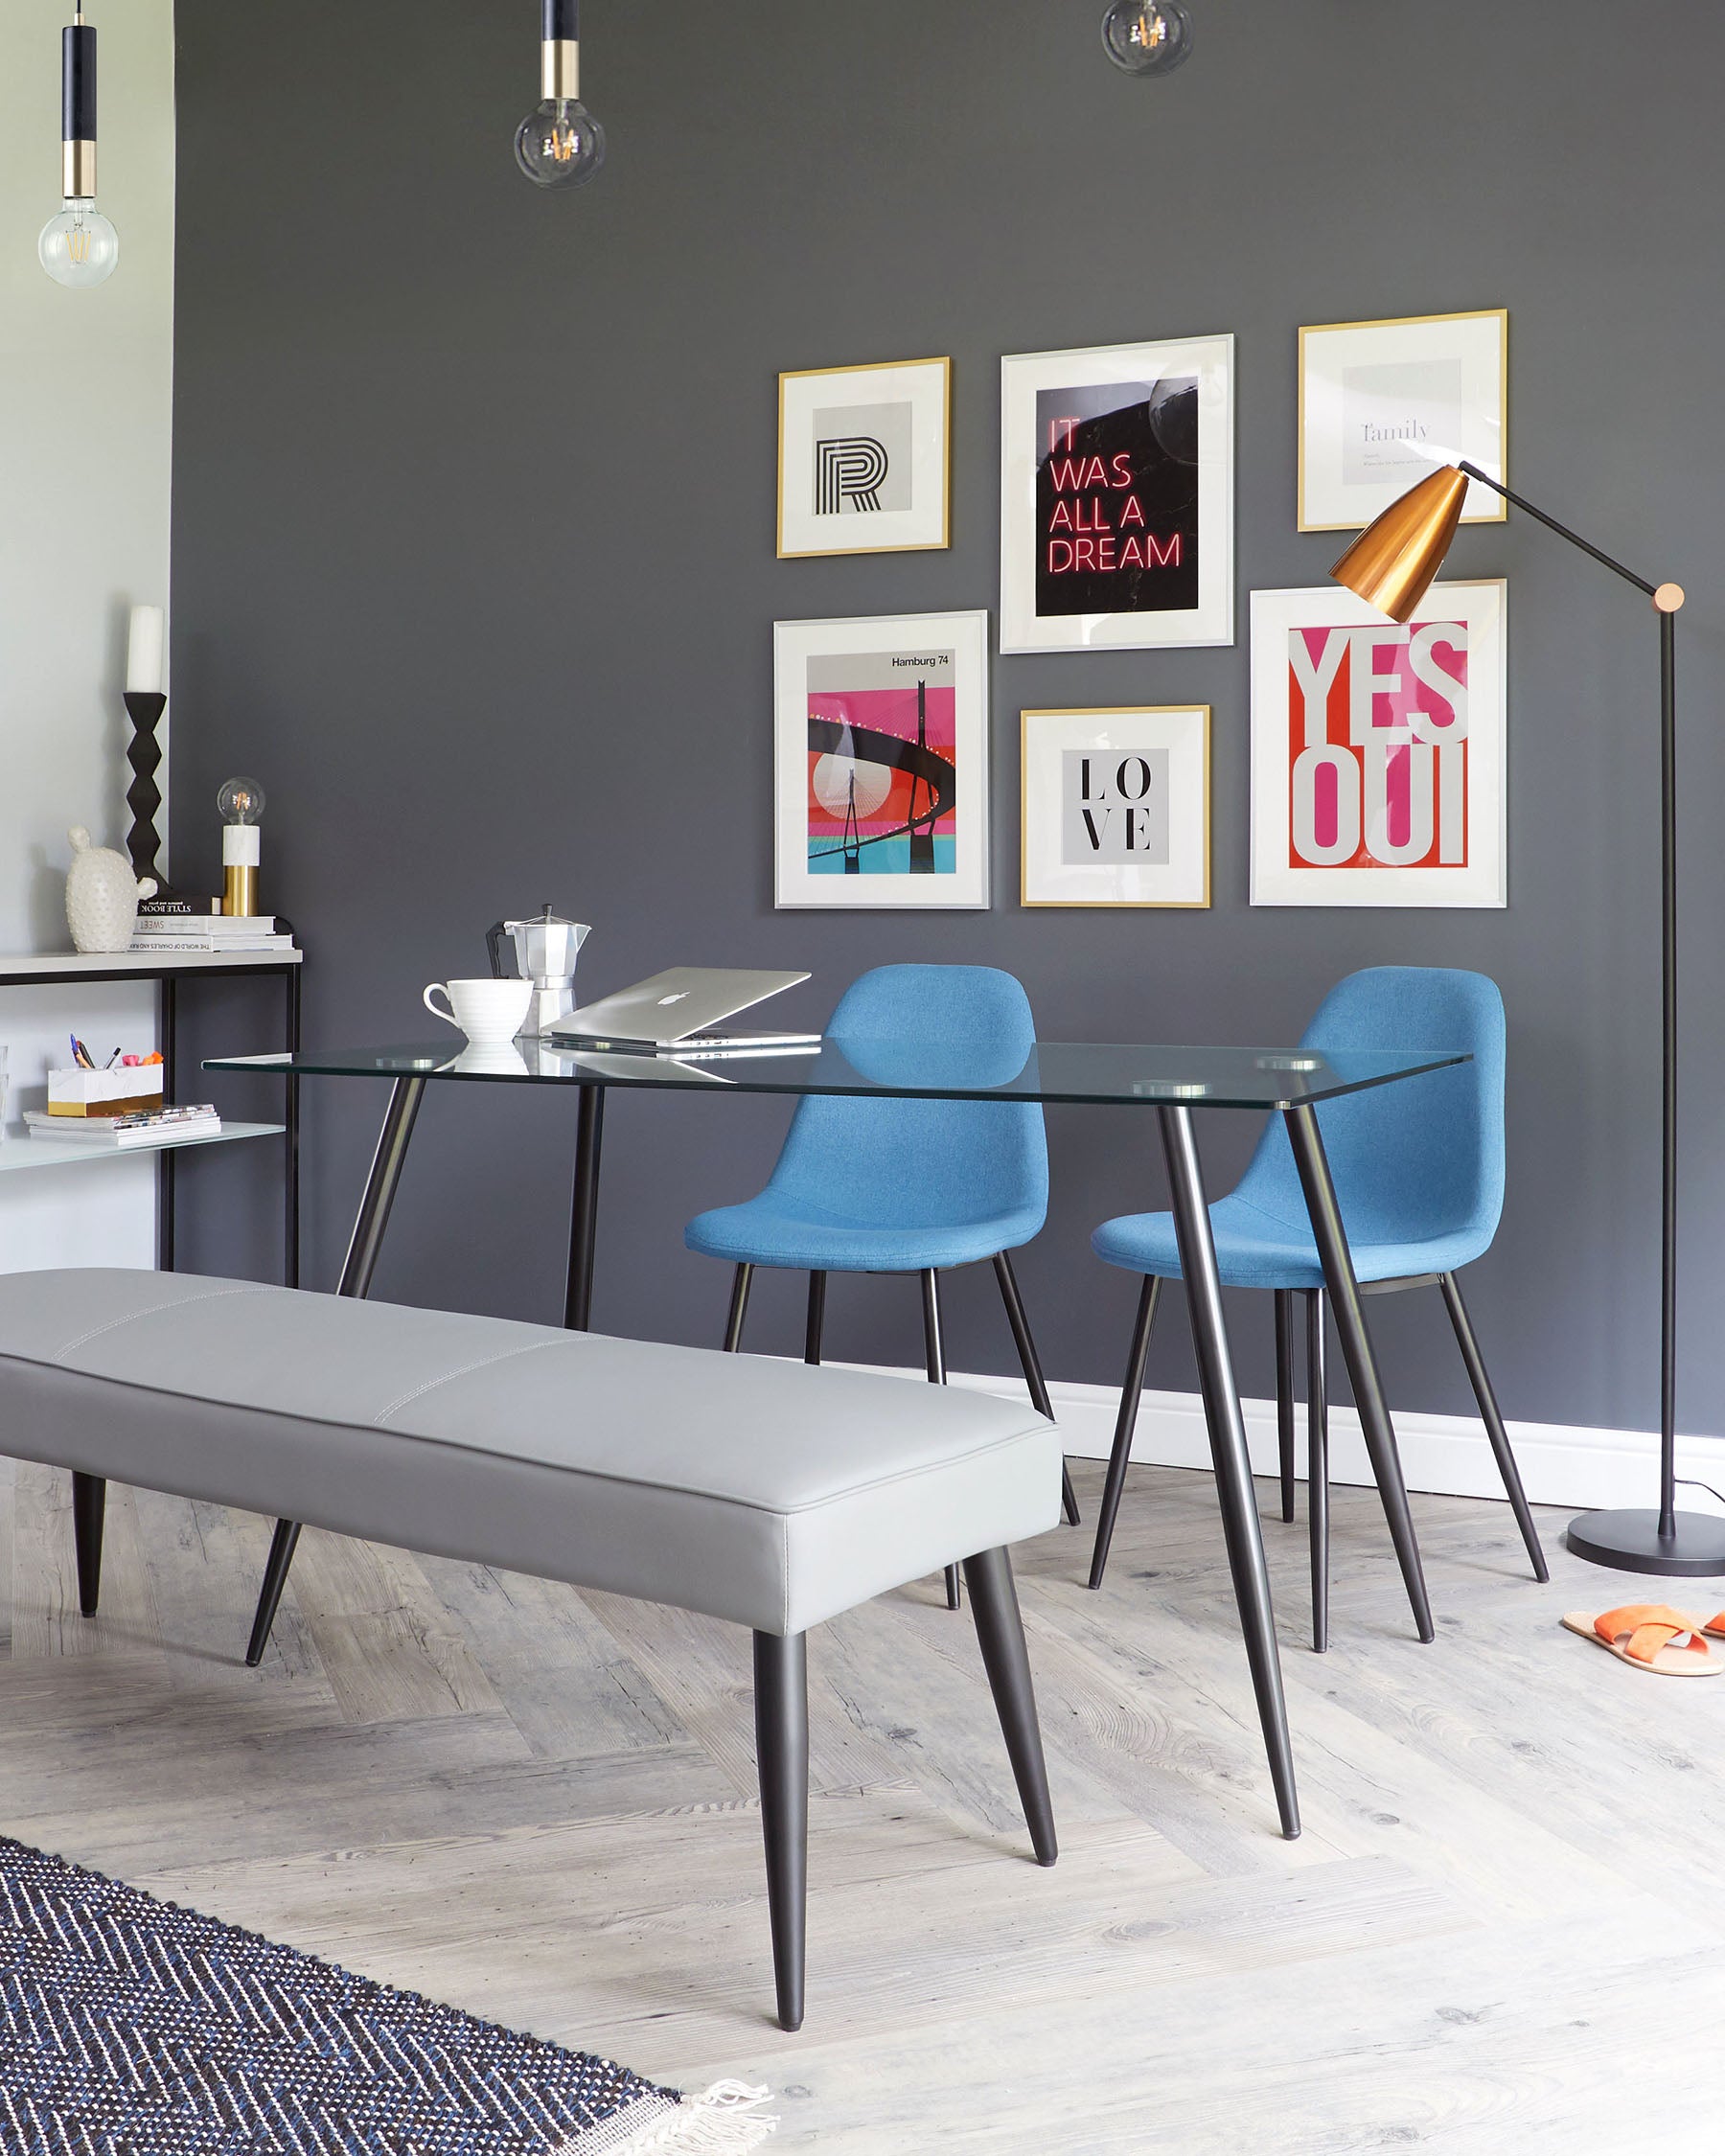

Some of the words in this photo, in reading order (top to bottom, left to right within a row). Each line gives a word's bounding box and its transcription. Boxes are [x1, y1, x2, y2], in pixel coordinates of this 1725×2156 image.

[1049, 416, 1081, 453] IT
[1363, 419, 1428, 443] family
[816, 436, 888, 516] R
[1048, 453, 1132, 493] WAS
[1048, 496, 1111, 533] ALL
[1119, 494, 1145, 528] A
[1048, 533, 1181, 573] DREAM
[892, 656, 935, 668] Hamburg
[938, 655, 949, 665] 74
[1289, 622, 1468, 747] YES
[1080, 756, 1152, 801] LO
[1293, 743, 1464, 866] OUI
[1078, 808, 1151, 851] VE
[140, 920, 164, 929] SWEET
